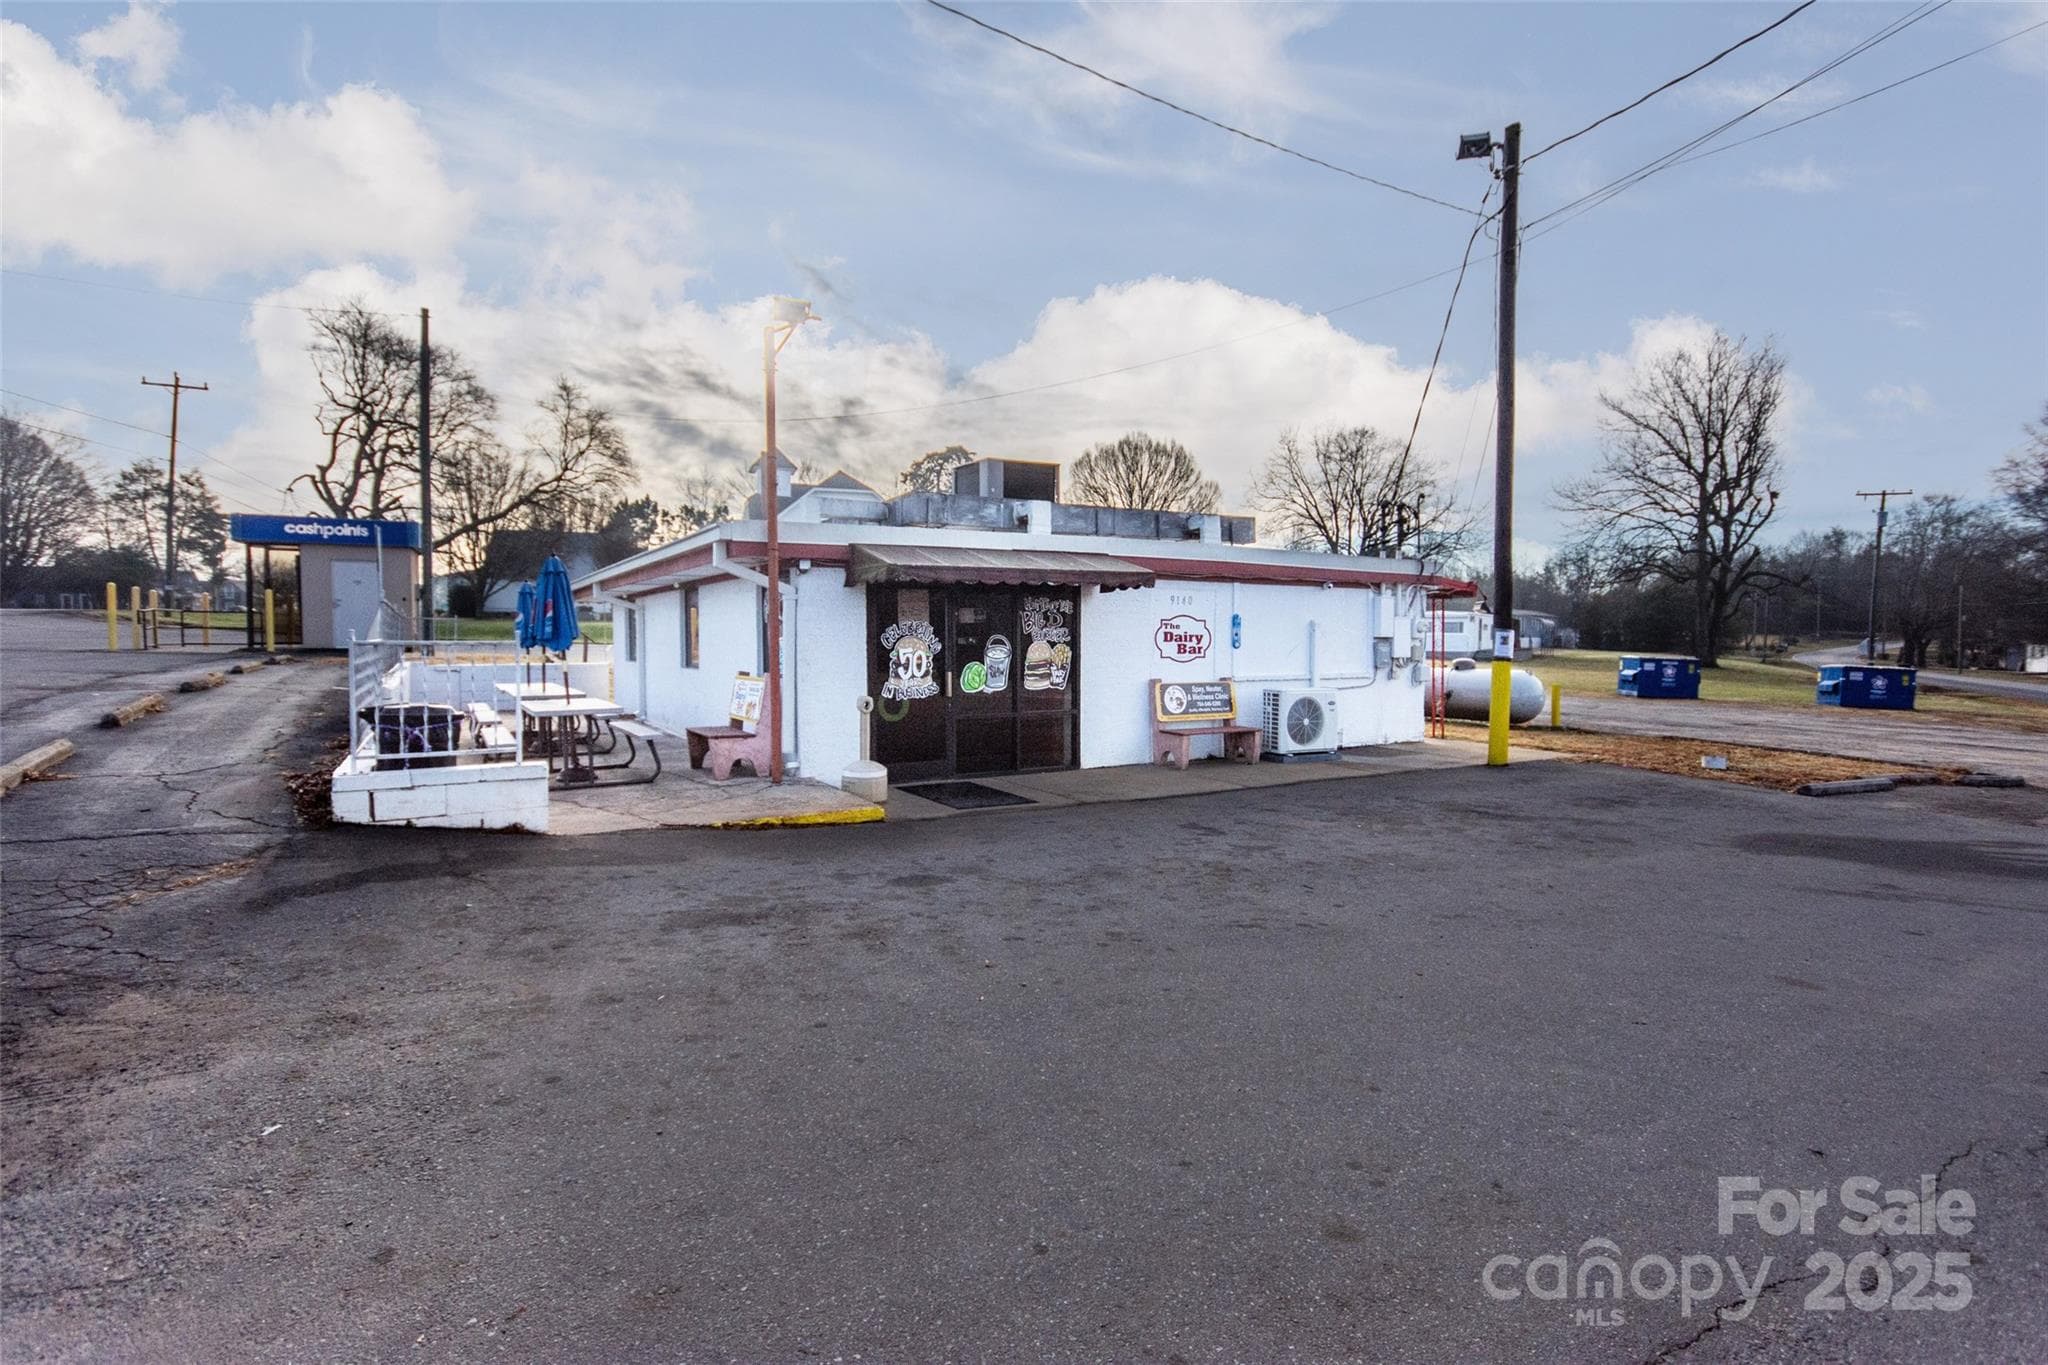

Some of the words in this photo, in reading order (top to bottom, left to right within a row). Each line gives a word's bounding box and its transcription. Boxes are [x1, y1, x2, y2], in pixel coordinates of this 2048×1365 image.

[284, 523, 369, 538] cashpoints
[1019, 611, 1046, 635] BIG
[1047, 610, 1063, 628] D
[1163, 622, 1181, 630] The
[881, 620, 942, 655] CELEBRATING
[1163, 631, 1204, 645] Dairy
[1177, 643, 1203, 655] Bar
[898, 647, 927, 680] 50
[881, 682, 895, 698] IN
[895, 682, 940, 701] BUSINESS
